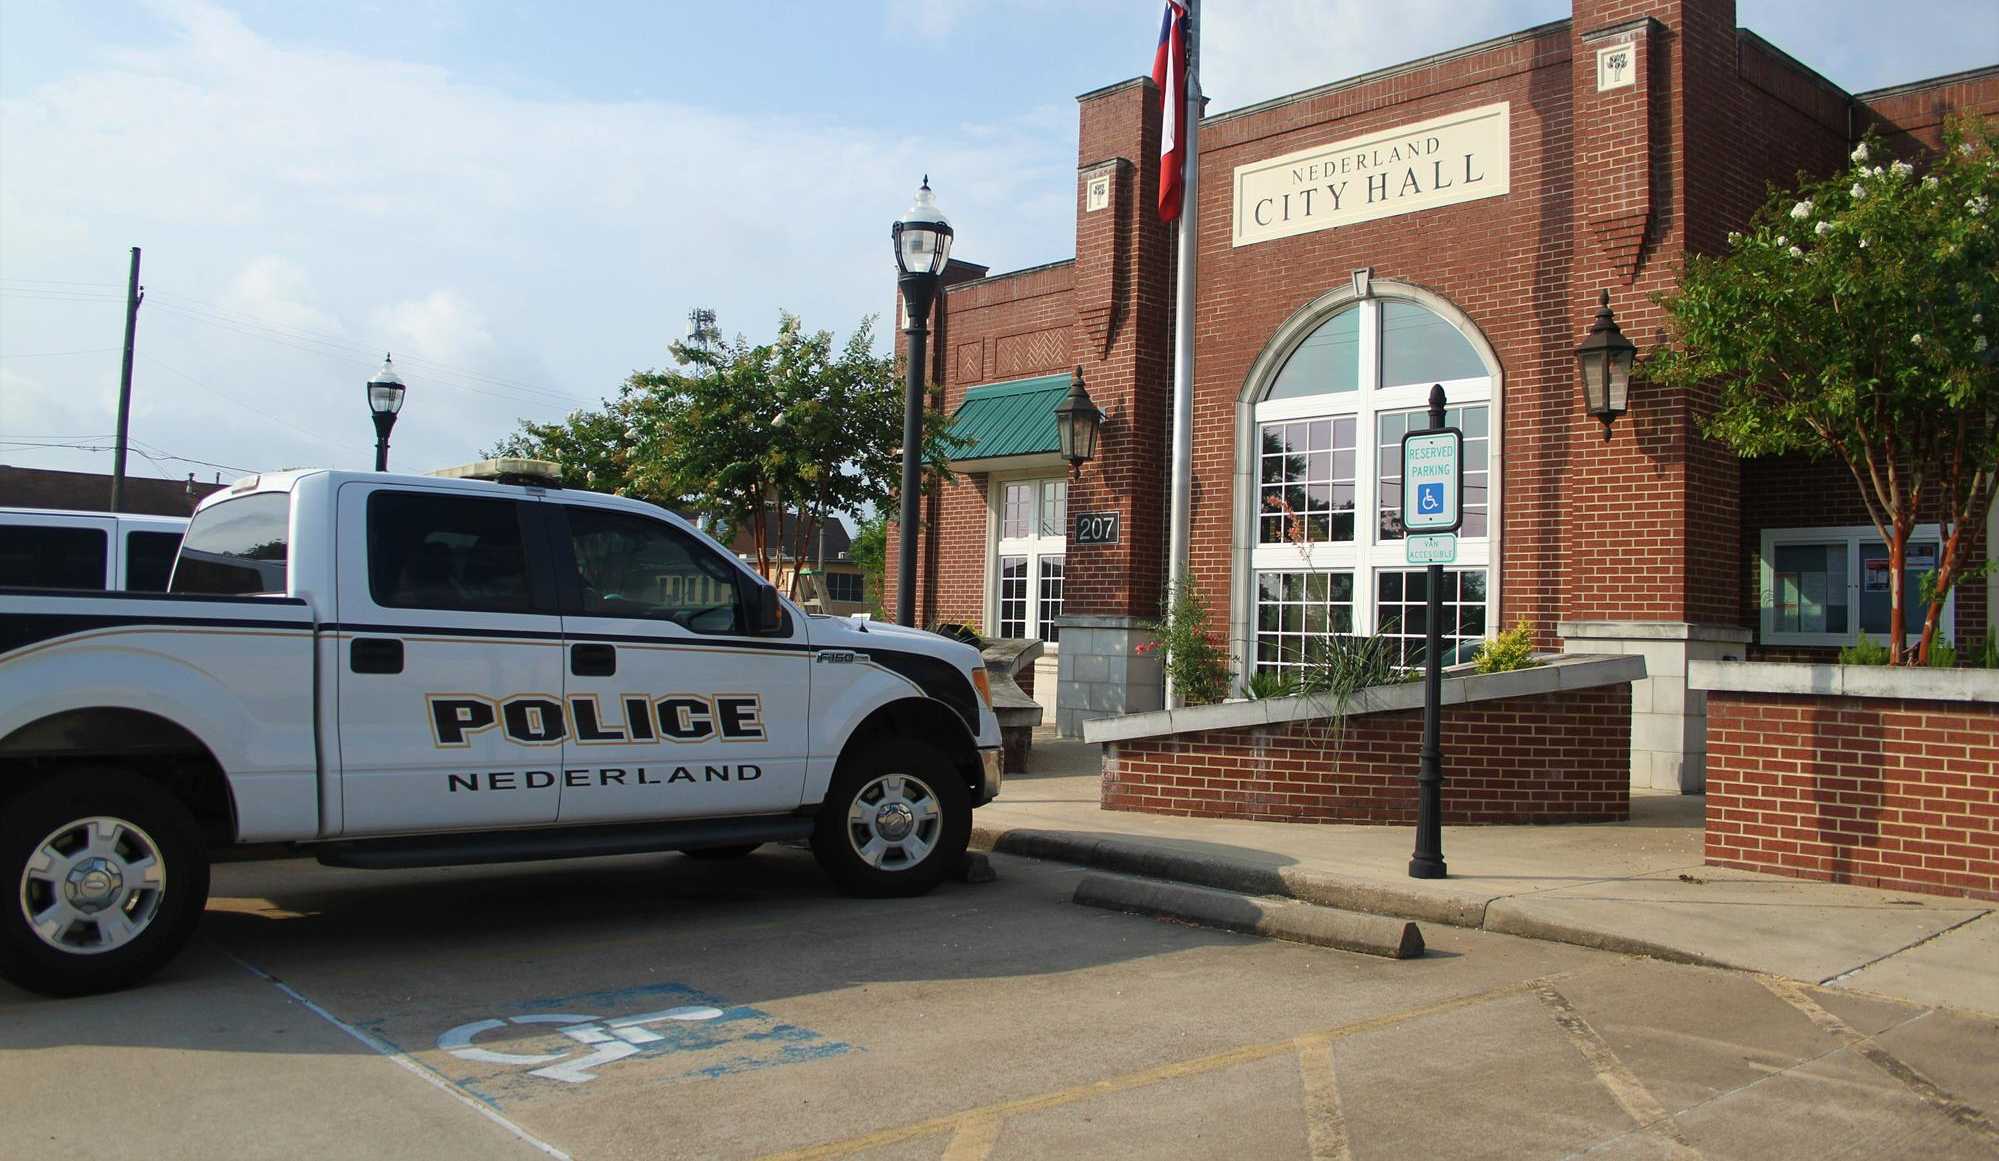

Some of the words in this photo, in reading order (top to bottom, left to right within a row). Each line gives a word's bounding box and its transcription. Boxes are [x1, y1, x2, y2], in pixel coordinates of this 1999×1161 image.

[1292, 137, 1440, 184] NEDERLAND
[1254, 181, 1348, 226] CITY
[1366, 153, 1484, 203] HALL
[1409, 446, 1453, 460] RESERVED
[1412, 464, 1450, 478] PARKING
[1080, 517, 1115, 540] 207
[1410, 550, 1453, 560] ACCESSIBLE
[1424, 540, 1439, 548] VAN
[425, 692, 768, 748] POLICE
[448, 764, 763, 792] NEDERLAND
